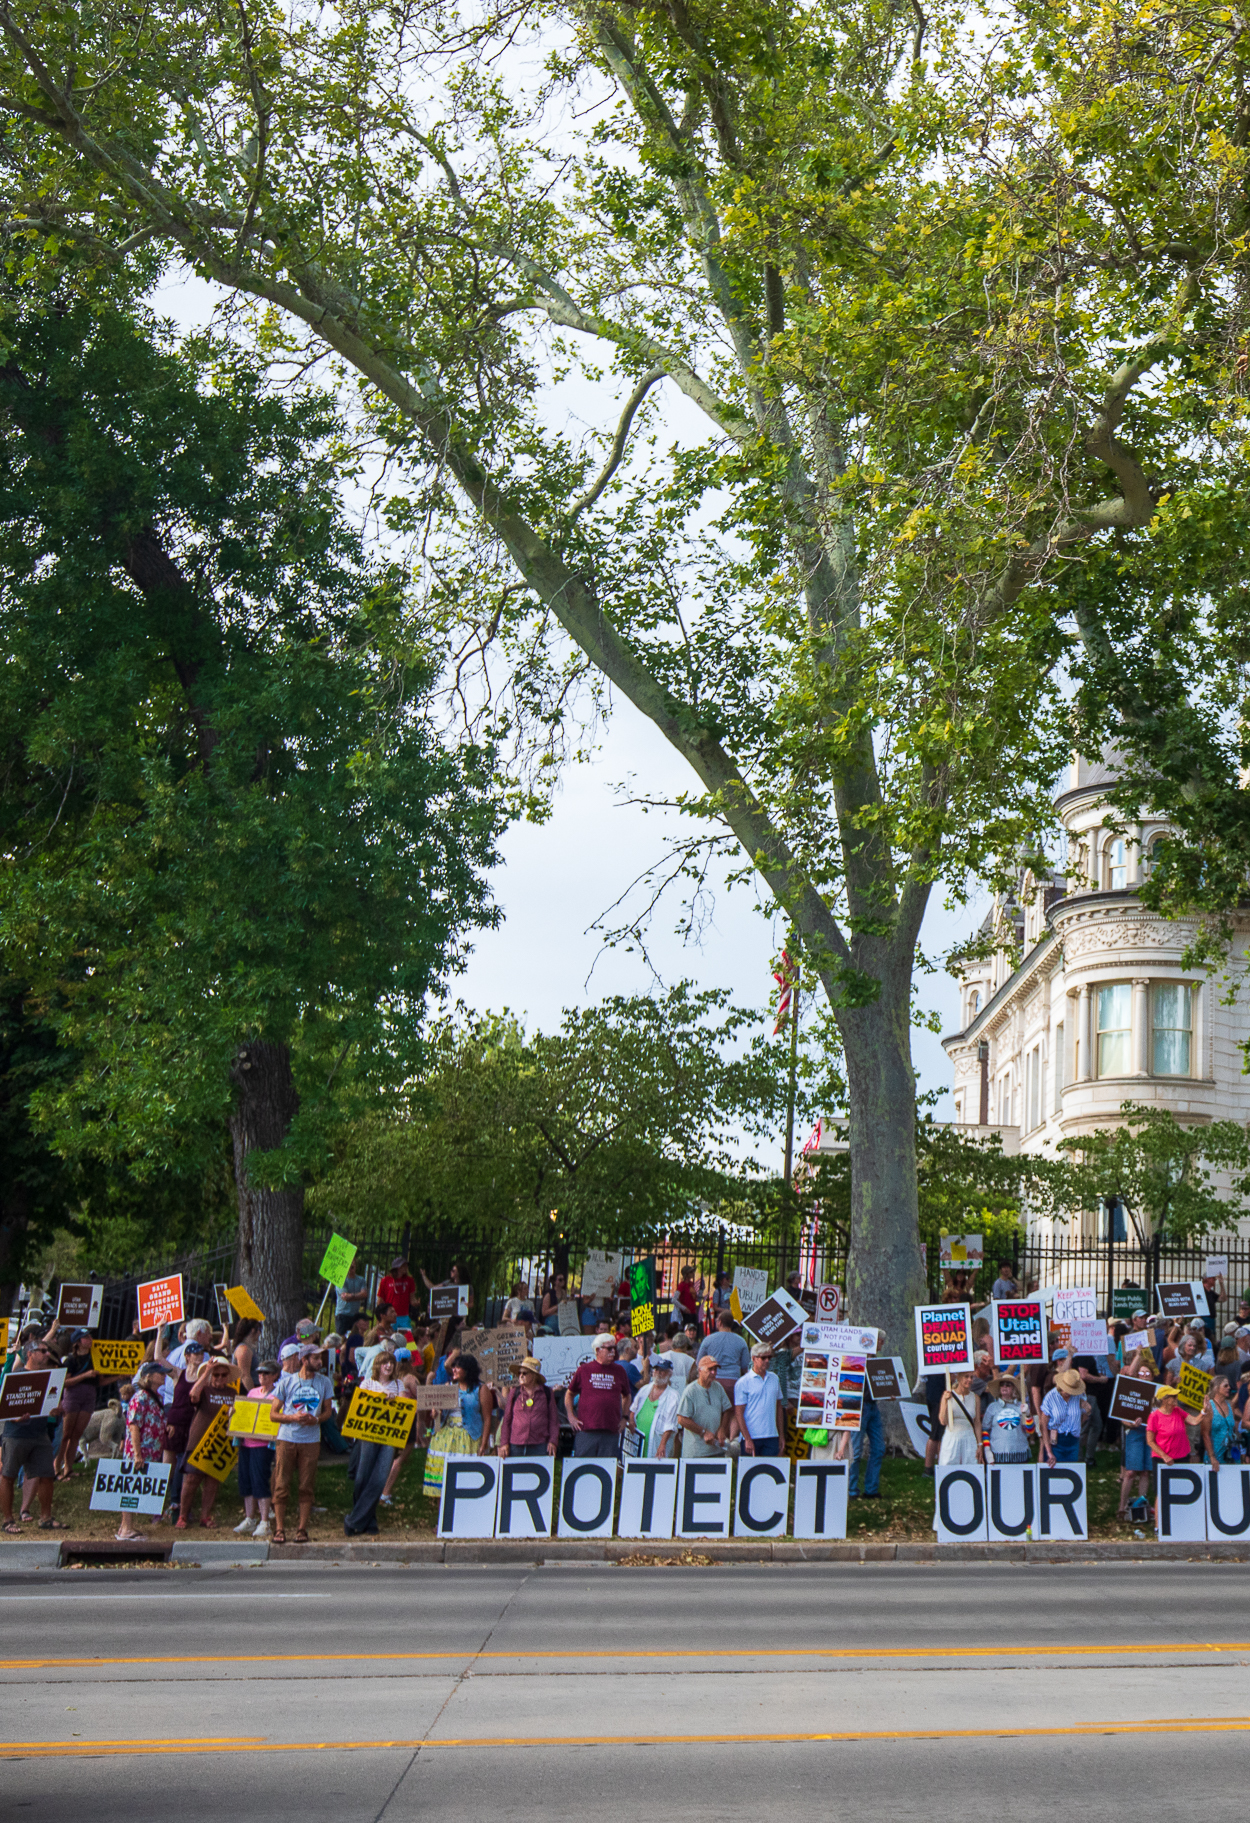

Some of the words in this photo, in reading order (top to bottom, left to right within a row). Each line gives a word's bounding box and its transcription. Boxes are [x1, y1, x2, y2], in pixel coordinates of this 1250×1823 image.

[740, 1268, 766, 1281] HANDS
[149, 1289, 171, 1300] GRAND
[152, 1283, 168, 1292] SAVE
[143, 1295, 178, 1309] STAIRCASE
[1057, 1291, 1074, 1300] KEEP
[1076, 1290, 1092, 1298] YOUR
[922, 1310, 965, 1322] Planet
[999, 1304, 1039, 1318] STOP
[1056, 1300, 1096, 1320] GREED
[758, 1320, 773, 1335] STANDS
[772, 1312, 783, 1322] WITH
[923, 1320, 965, 1333] DEATH
[1000, 1317, 1040, 1331] Utah
[840, 1327, 862, 1335] LANDS
[924, 1331, 966, 1344] SQUAD
[1001, 1330, 1041, 1345] Land
[100, 1350, 138, 1358] WILD
[927, 1344, 956, 1352] courtesy
[1001, 1344, 1042, 1358] RAPE
[925, 1350, 967, 1364] TRUMP
[1184, 1366, 1212, 1382] Prote
[825, 1357, 839, 1423] SHAME
[1184, 1376, 1209, 1394] UTA
[1180, 1386, 1204, 1403] SILVES
[358, 1392, 414, 1412] Protege
[356, 1404, 408, 1426] UTAH
[346, 1418, 408, 1440] SILVESTRE
[213, 1436, 238, 1471] UTA
[96, 1474, 167, 1497] BEARABLE
[442, 1462, 846, 1534] PROTECT
[940, 1468, 1083, 1536] OUR
